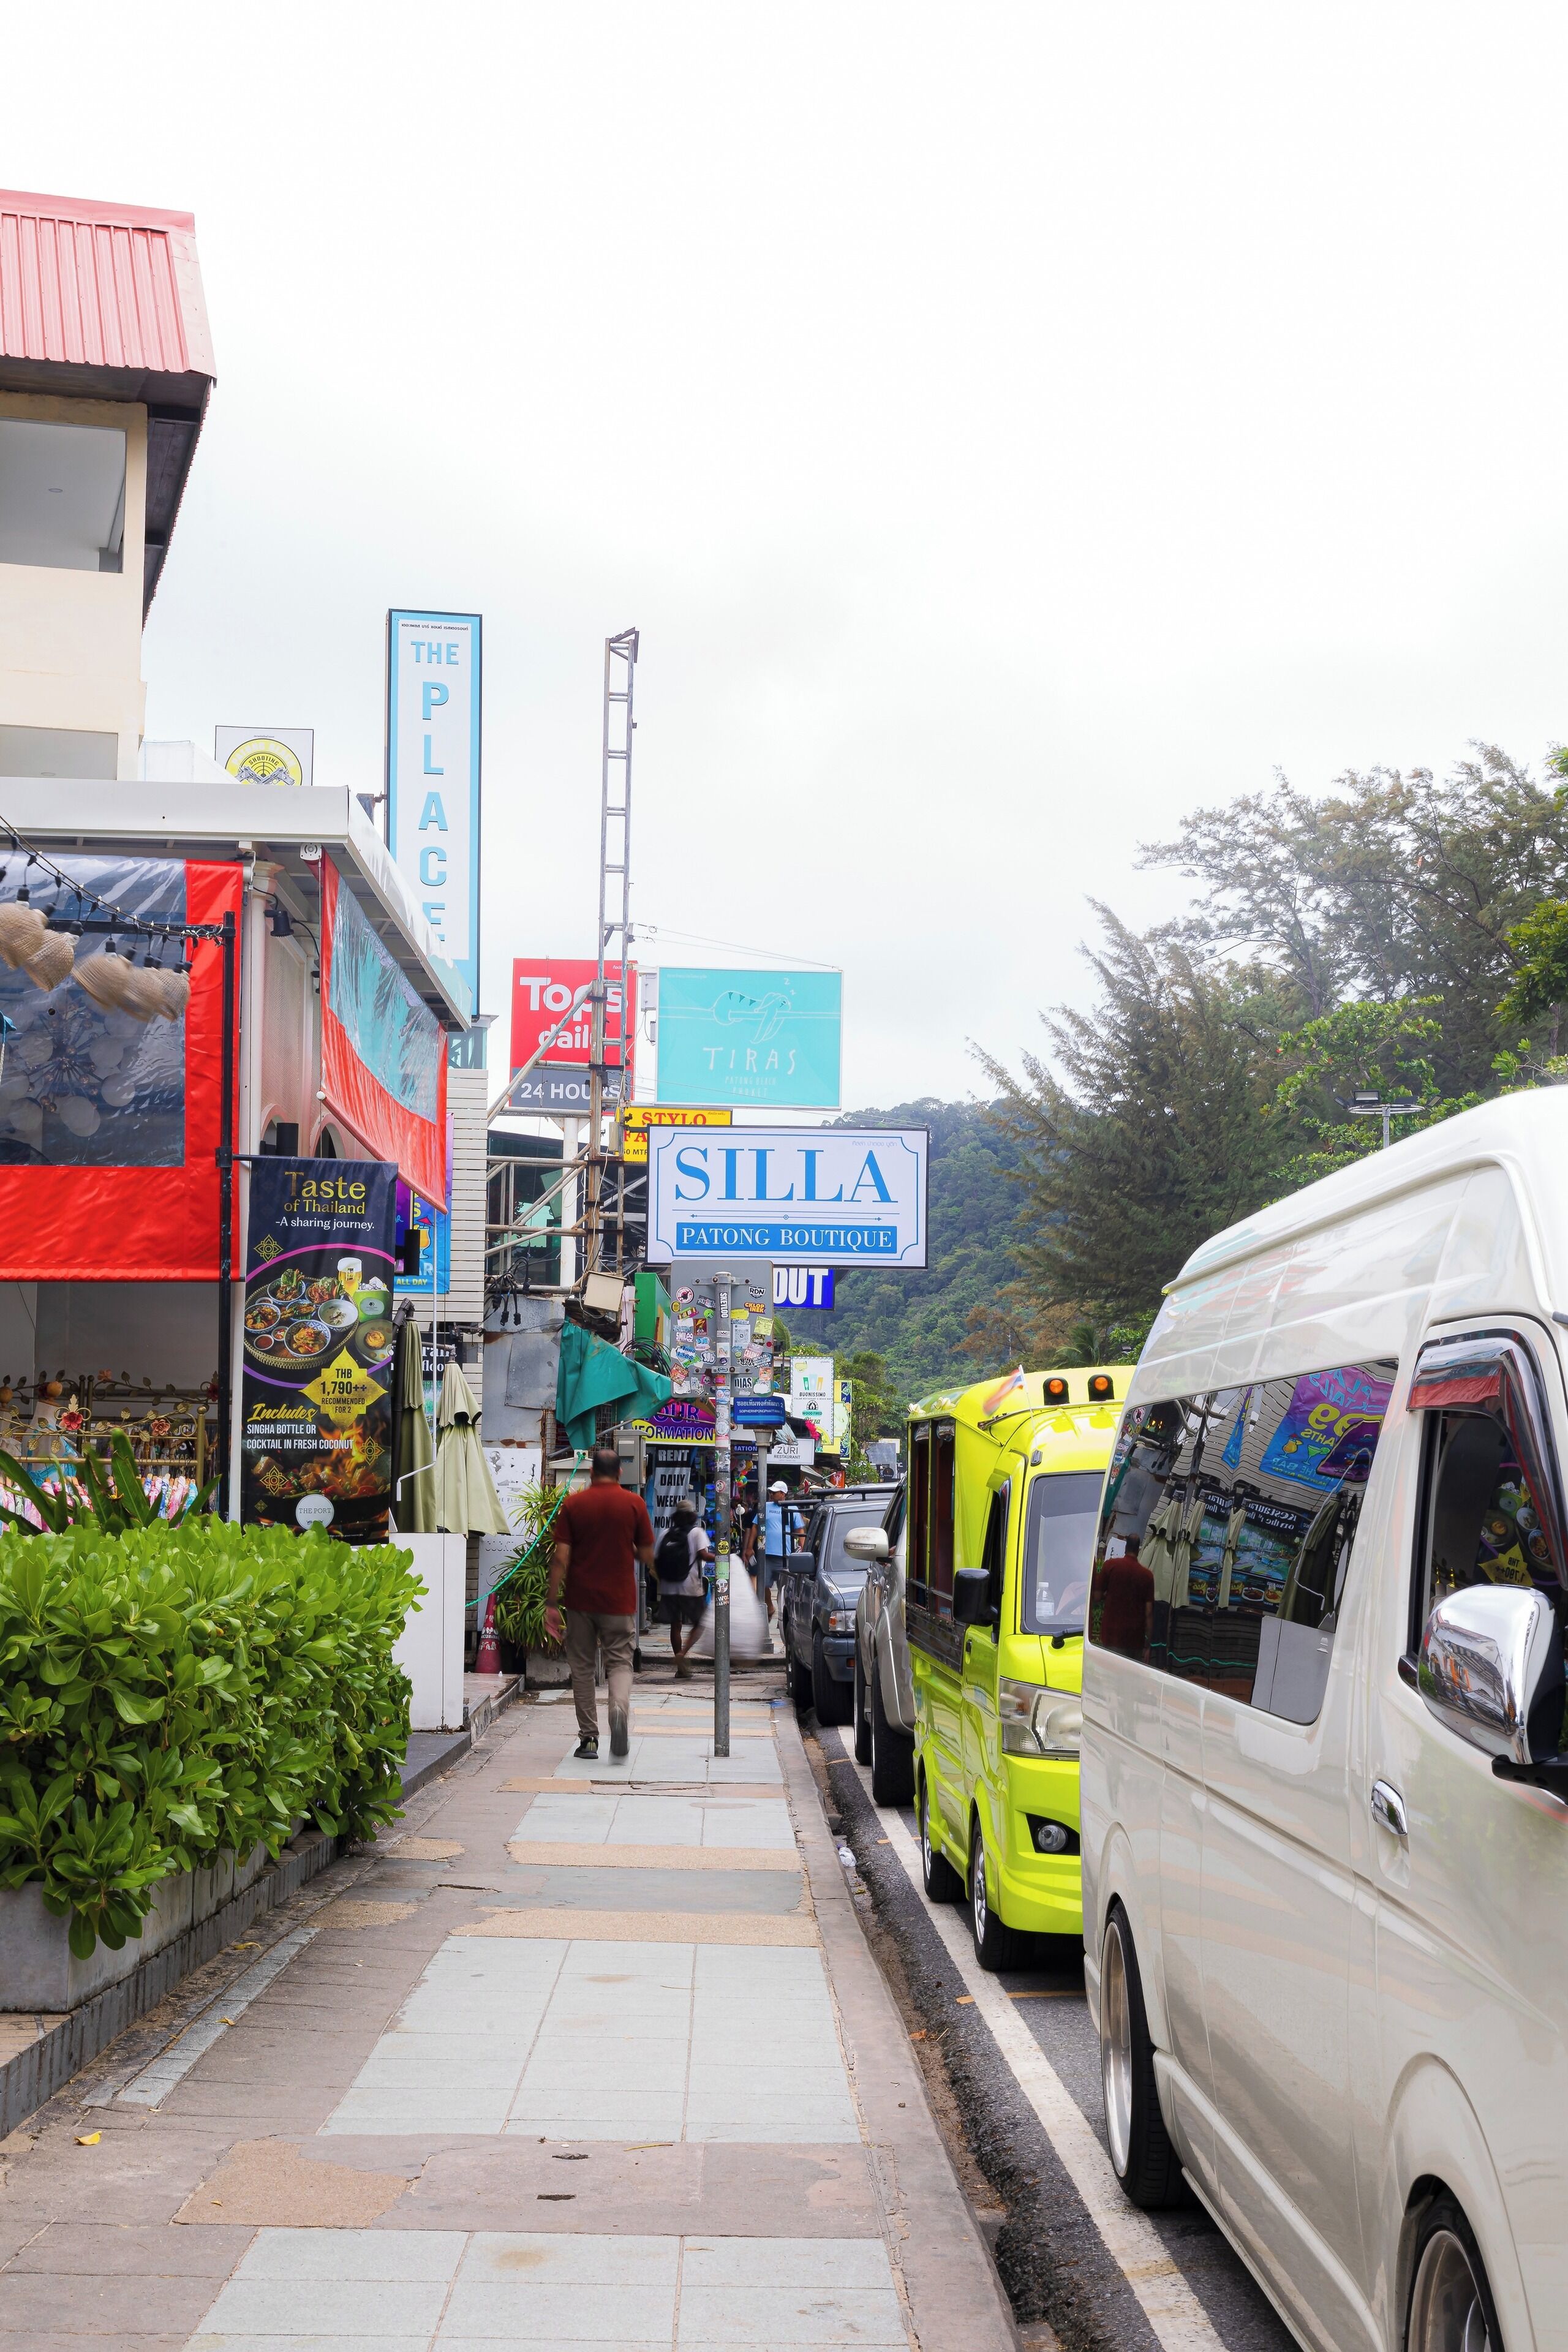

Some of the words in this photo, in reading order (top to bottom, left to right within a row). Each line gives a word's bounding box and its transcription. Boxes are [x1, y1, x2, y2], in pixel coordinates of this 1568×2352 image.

[410, 641, 459, 665] THE
[249, 755, 279, 766] SHOOTING
[418, 681, 450, 941] PLACE
[538, 1024, 606, 1049] dail
[703, 1047, 796, 1075] TIRAS
[725, 1076, 753, 1086] PATONG
[521, 1083, 544, 1098] 24
[733, 1087, 768, 1097] PHUKET
[642, 1112, 707, 1125] STYLO
[675, 1147, 899, 1202] SILLA
[284, 1171, 366, 1199] Taste
[284, 1199, 300, 1212] of
[303, 1199, 366, 1215] Thailand
[290, 1216, 331, 1231] sharing
[333, 1218, 375, 1232] journey.
[682, 1227, 771, 1246] PATONG
[780, 1229, 892, 1251] BOUTIQUE
[412, 1278, 428, 1286] DAY
[336, 1368, 352, 1379] THB
[320, 1381, 368, 1396] 1,790++
[247, 1403, 318, 1422] Includes
[247, 1424, 275, 1434] SINGHA
[276, 1424, 305, 1434] BOTTLE
[306, 1425, 316, 1434] OR
[247, 1439, 282, 1450] COCKTAIL
[284, 1439, 293, 1450] IN
[293, 1439, 317, 1450] FRESH
[319, 1439, 354, 1450] COCONUT
[658, 1450, 689, 1461] RENT
[660, 1474, 686, 1487] DAILY
